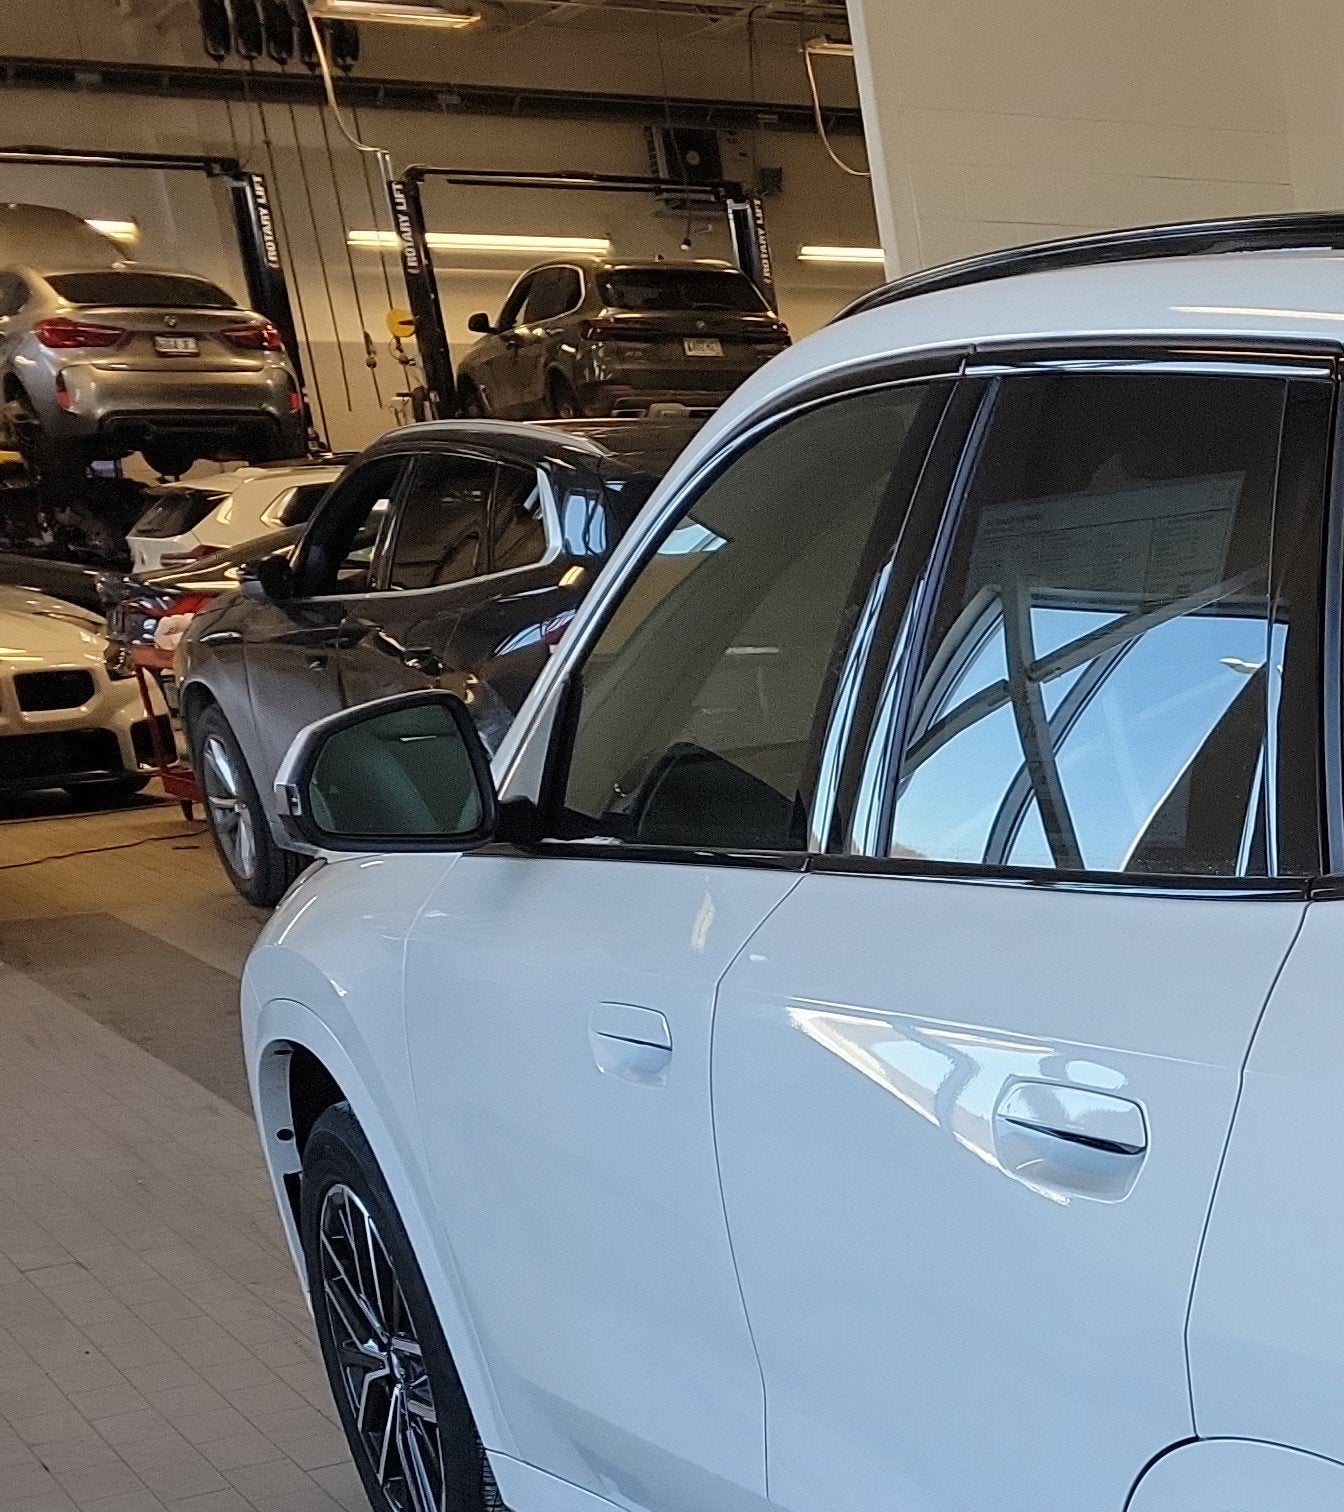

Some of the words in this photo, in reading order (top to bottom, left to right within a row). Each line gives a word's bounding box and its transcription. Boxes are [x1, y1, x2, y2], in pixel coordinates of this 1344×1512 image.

[251, 174, 267, 205] LIFT
[391, 181, 407, 210] LIFT
[258, 206, 278, 262] ROTARY
[397, 213, 419, 267] ROTARY
